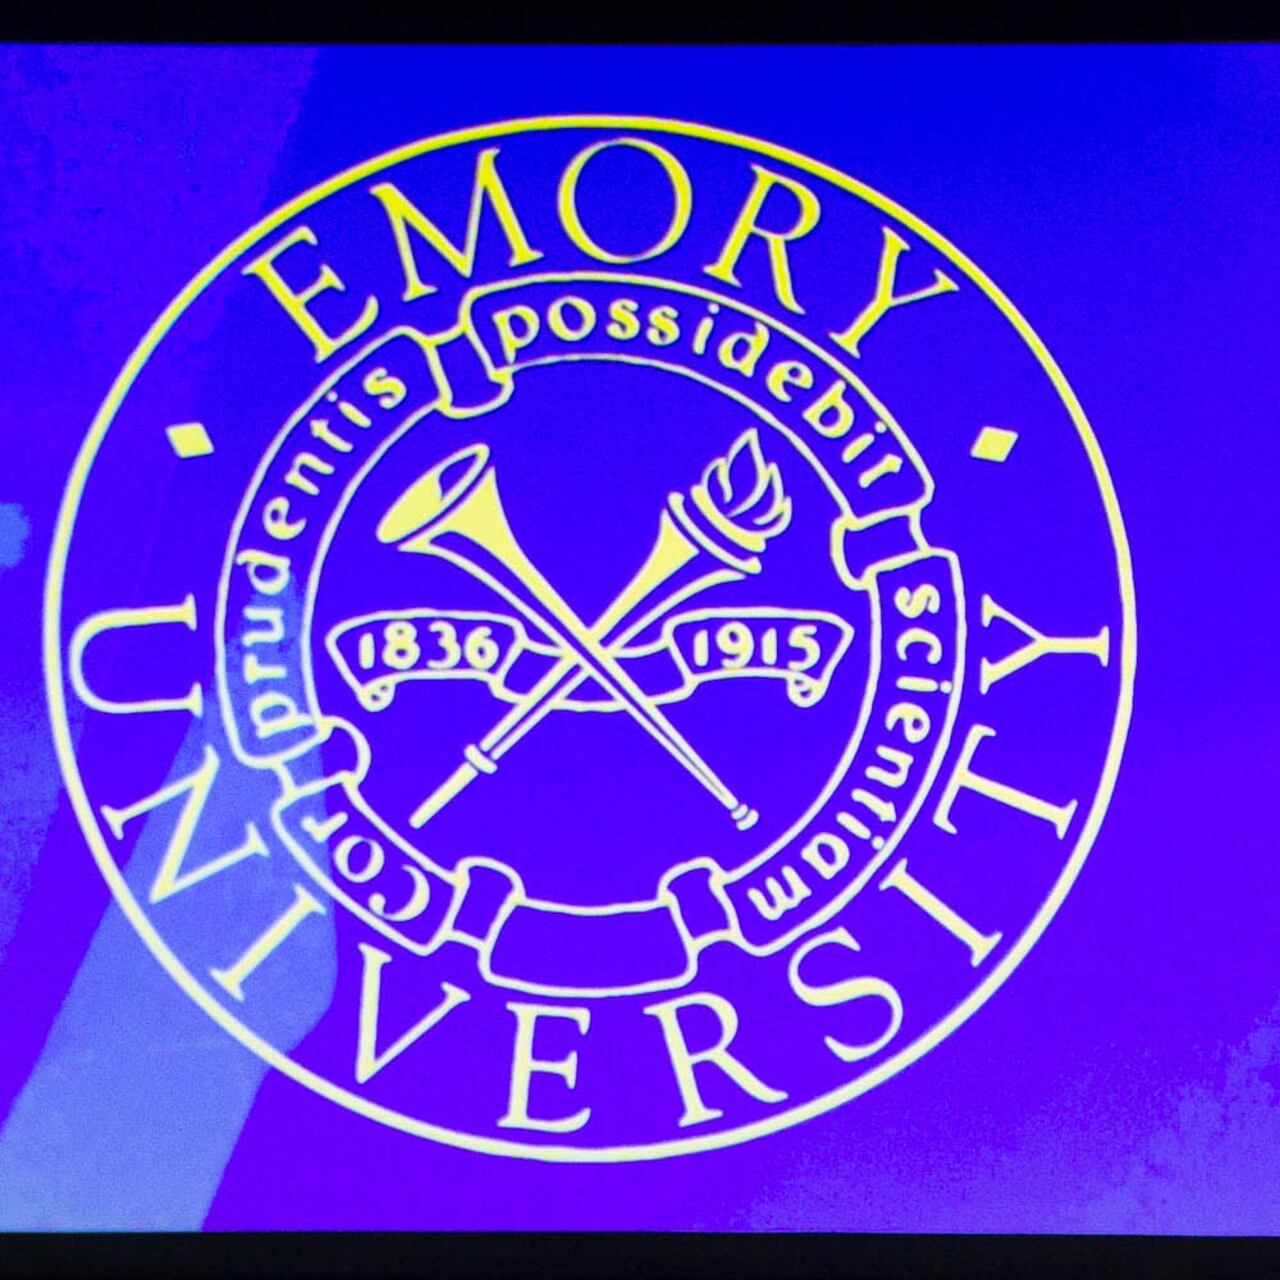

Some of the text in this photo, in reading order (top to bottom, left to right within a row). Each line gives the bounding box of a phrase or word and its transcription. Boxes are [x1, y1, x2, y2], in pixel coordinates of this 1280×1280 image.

[241, 137, 960, 363] EMORY
[235, 295, 943, 922] Cor prudentis possidebit scientiam
[358, 622, 500, 672] 1836
[693, 624, 822, 673] 1915
[68, 593, 1111, 1134] UNIVERSITY
